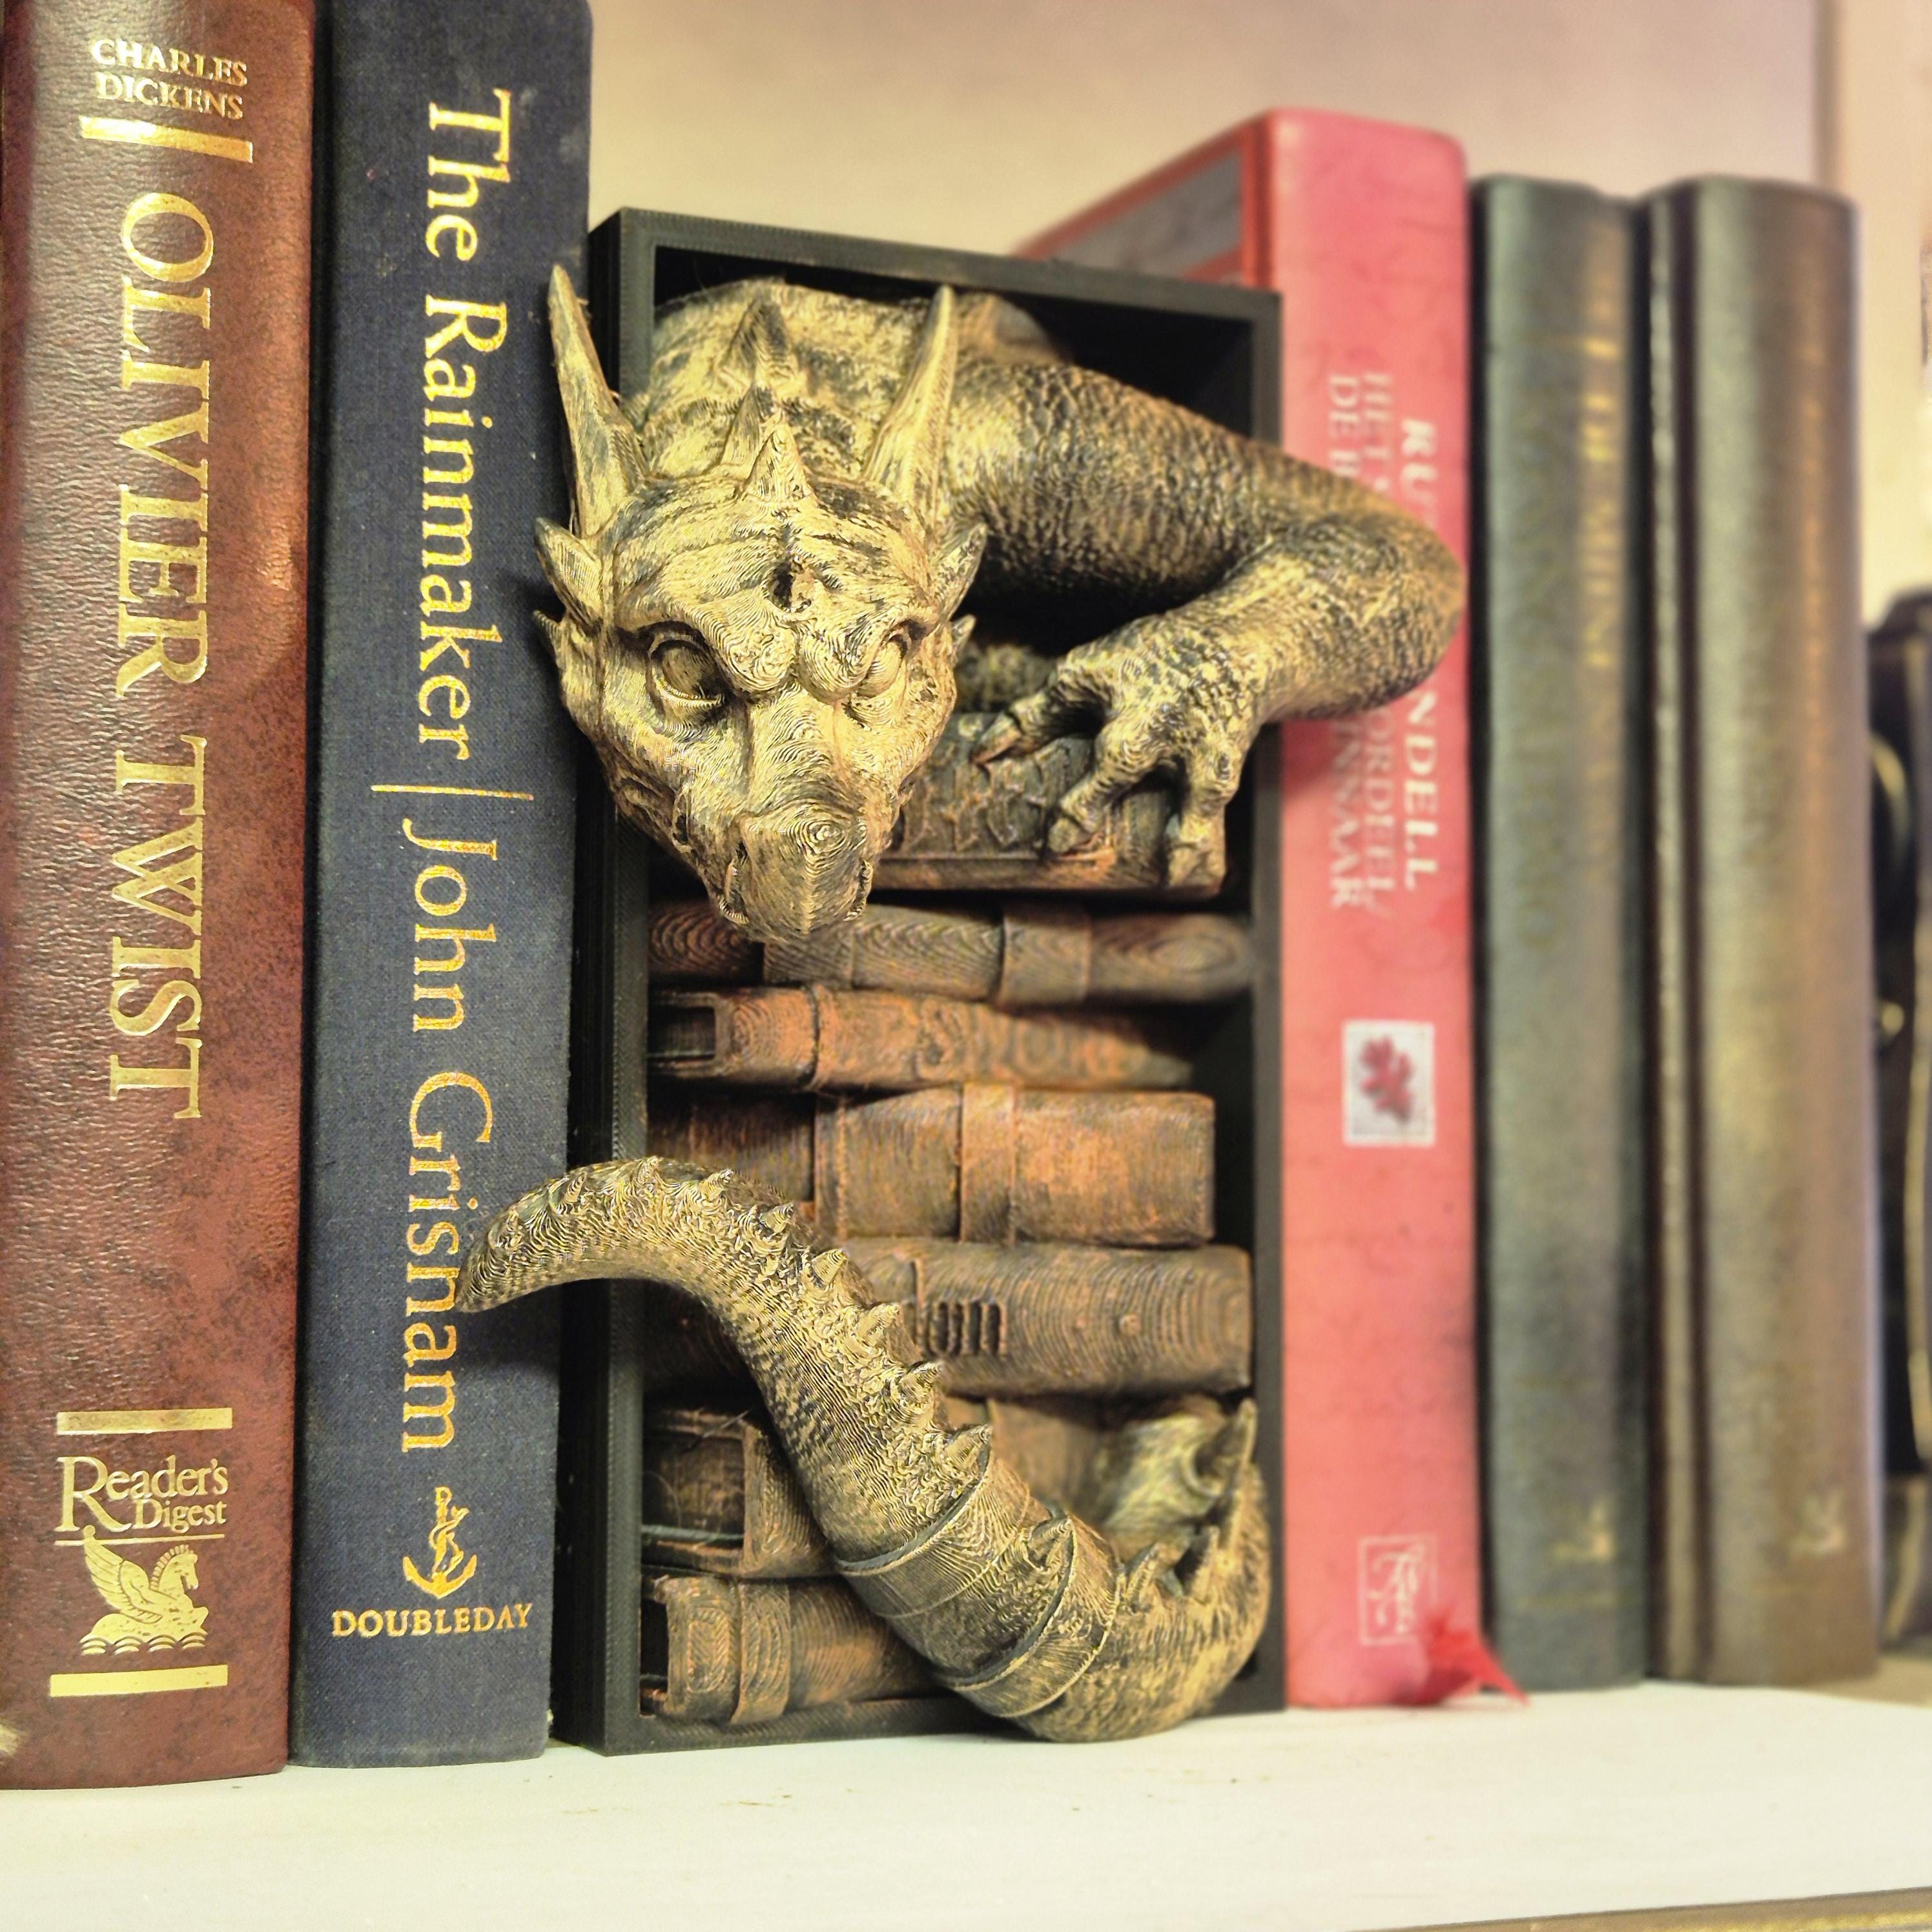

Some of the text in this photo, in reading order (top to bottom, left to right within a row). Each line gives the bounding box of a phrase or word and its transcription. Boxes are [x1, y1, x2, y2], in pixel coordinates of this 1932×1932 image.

[92, 37, 248, 87] CHARLES
[97, 72, 243, 120] DICKENS
[108, 192, 214, 1119] OLIVER TWIST
[402, 88, 512, 1453] The Rainmaker John Grisham
[1404, 690, 1441, 892] NDELL
[55, 1454, 229, 1534] Reader's
[130, 1497, 227, 1534] Digest
[332, 1603, 533, 1638] DOUBLEDAY
